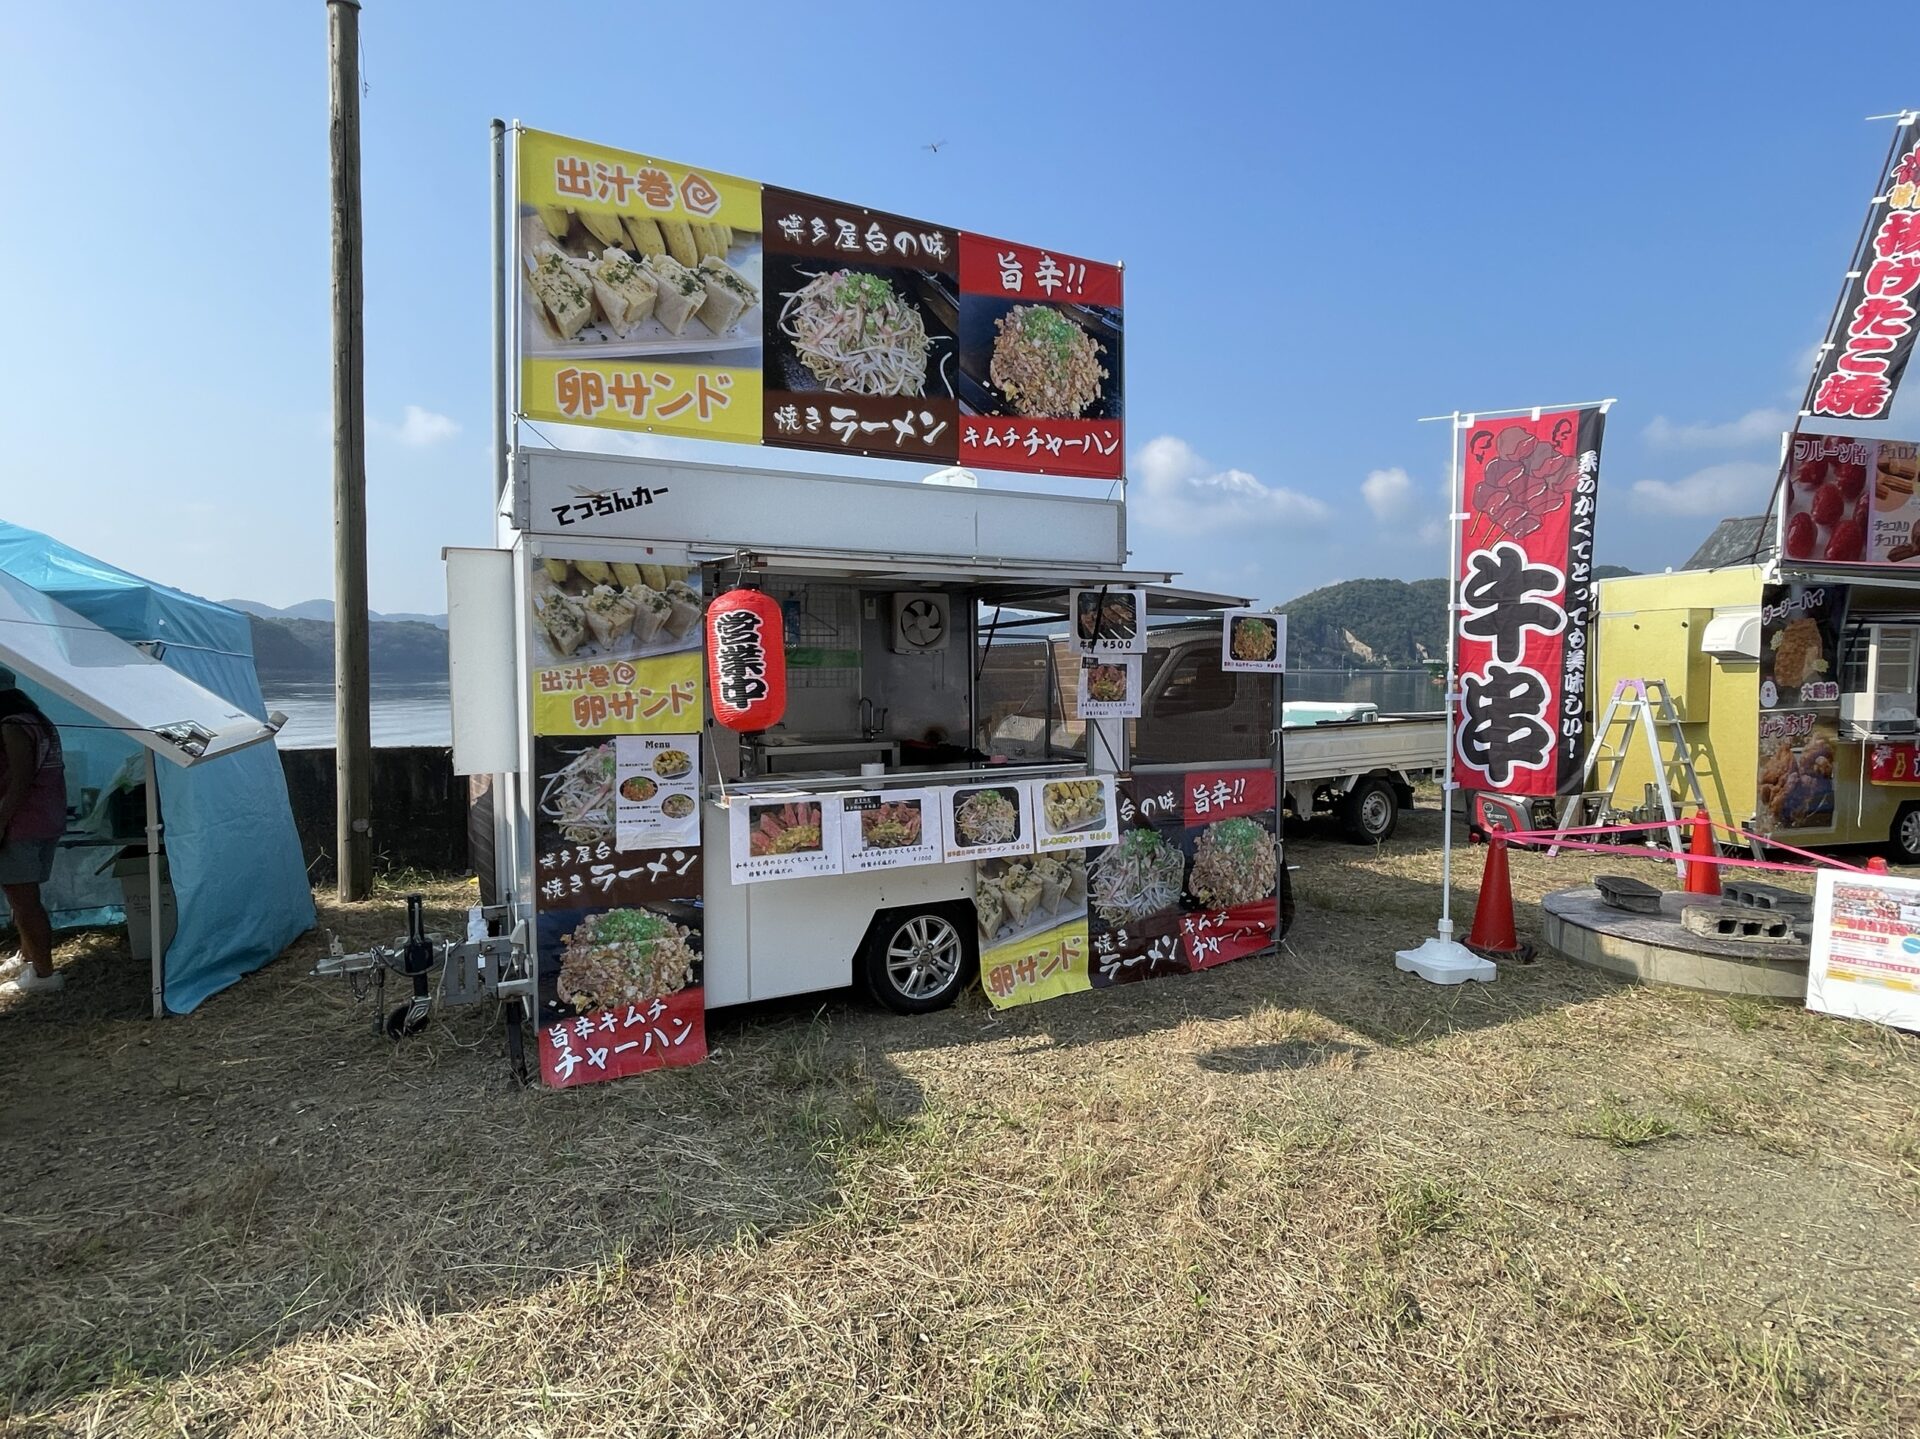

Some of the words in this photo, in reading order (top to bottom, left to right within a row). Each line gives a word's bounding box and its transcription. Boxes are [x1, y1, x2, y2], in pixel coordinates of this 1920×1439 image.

[556, 156, 673, 210] 出汁巻
[777, 214, 950, 261] 博多屋台の味
[556, 366, 733, 420] 卵サンド
[773, 402, 949, 445] 焼きラーメン
[961, 424, 1121, 458] キムチチャーハン
[714, 609, 769, 712] 営業中
[1103, 640, 1132, 649] ¥500
[1458, 540, 1569, 788] 牛串
[541, 665, 611, 693] 出汁巻
[573, 680, 696, 729] 卵サンド
[1760, 713, 1817, 739] からあげ
[645, 740, 671, 749] Menu
[1115, 783, 1177, 822] 台の味
[539, 842, 623, 870] 博多屋台
[1094, 928, 1129, 954] 焼き
[1184, 911, 1230, 934] キムチ
[987, 938, 1081, 997] 卵サンド
[1099, 934, 1178, 980] ラーメン
[553, 1017, 693, 1082] チャーハン
